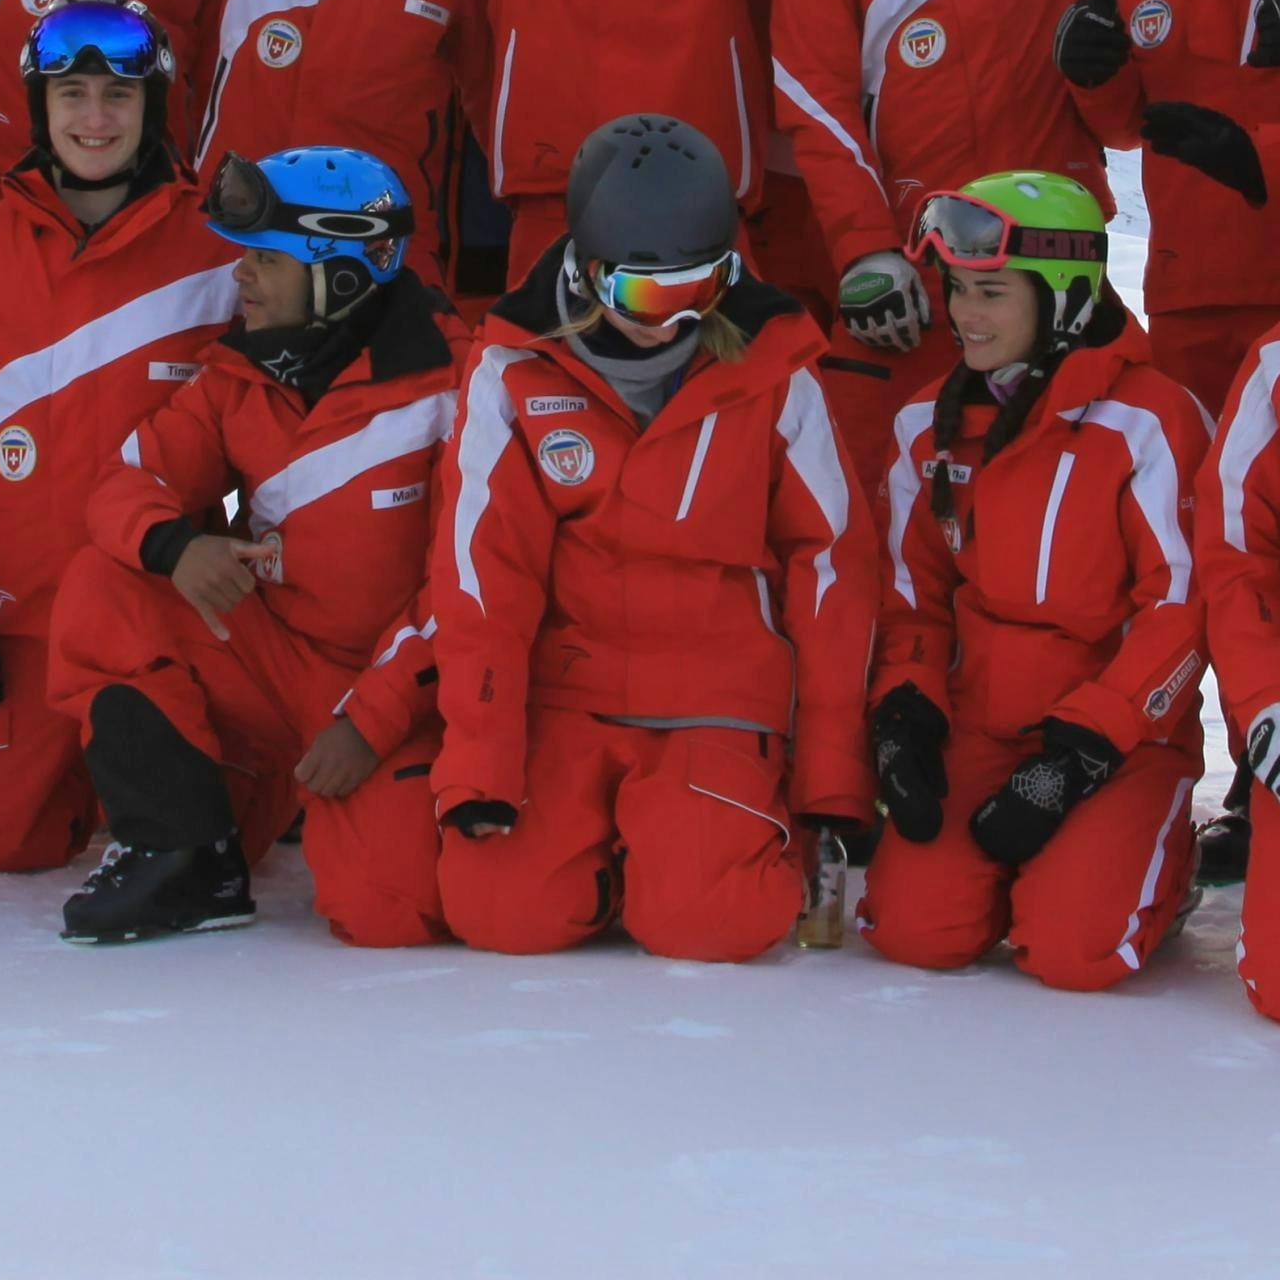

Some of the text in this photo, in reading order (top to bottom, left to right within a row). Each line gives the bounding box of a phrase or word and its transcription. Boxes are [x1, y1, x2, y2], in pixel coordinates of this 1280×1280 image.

[530, 398, 586, 412] Carolina
[392, 487, 419, 503] Maik
[1167, 659, 1199, 696] LEAGUE
